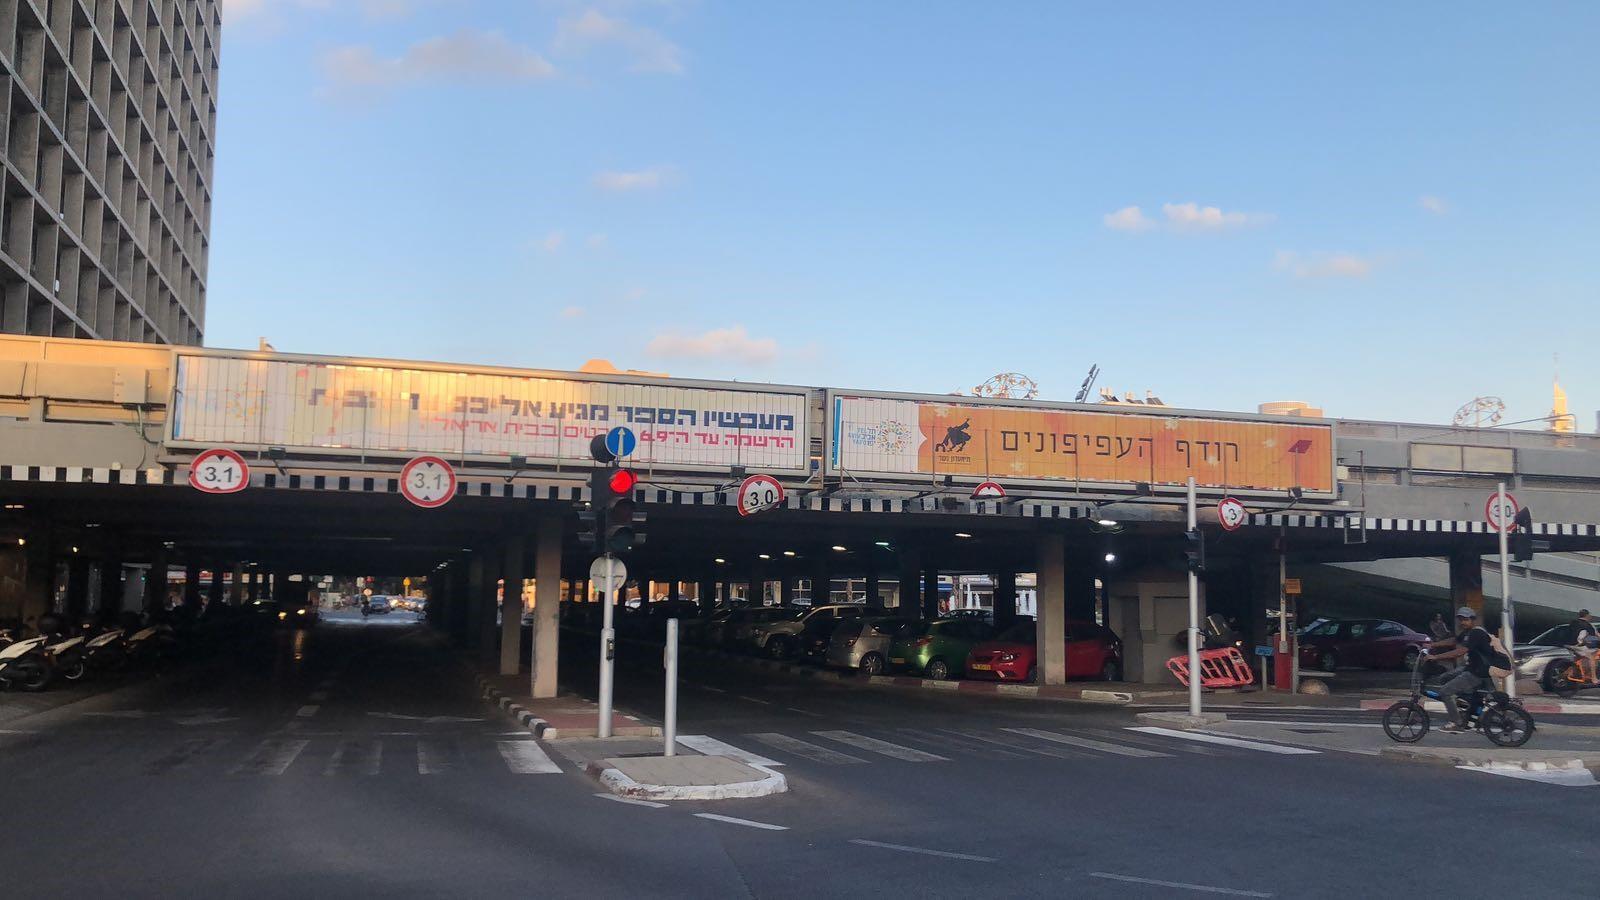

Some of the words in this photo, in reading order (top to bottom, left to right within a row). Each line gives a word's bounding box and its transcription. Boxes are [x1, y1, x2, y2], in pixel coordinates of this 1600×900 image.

[549, 401, 609, 421] מגיע
[503, 422, 559, 437] בבית
[703, 410, 794, 431] מעכשיו
[694, 432, 719, 445] עד
[724, 433, 794, 448] הרשמה
[1000, 430, 1153, 459] העפיפונים
[1176, 438, 1238, 468] רודף
[204, 466, 233, 483] 3.1
[414, 472, 442, 490] 3.1
[750, 489, 774, 507] 3.0
